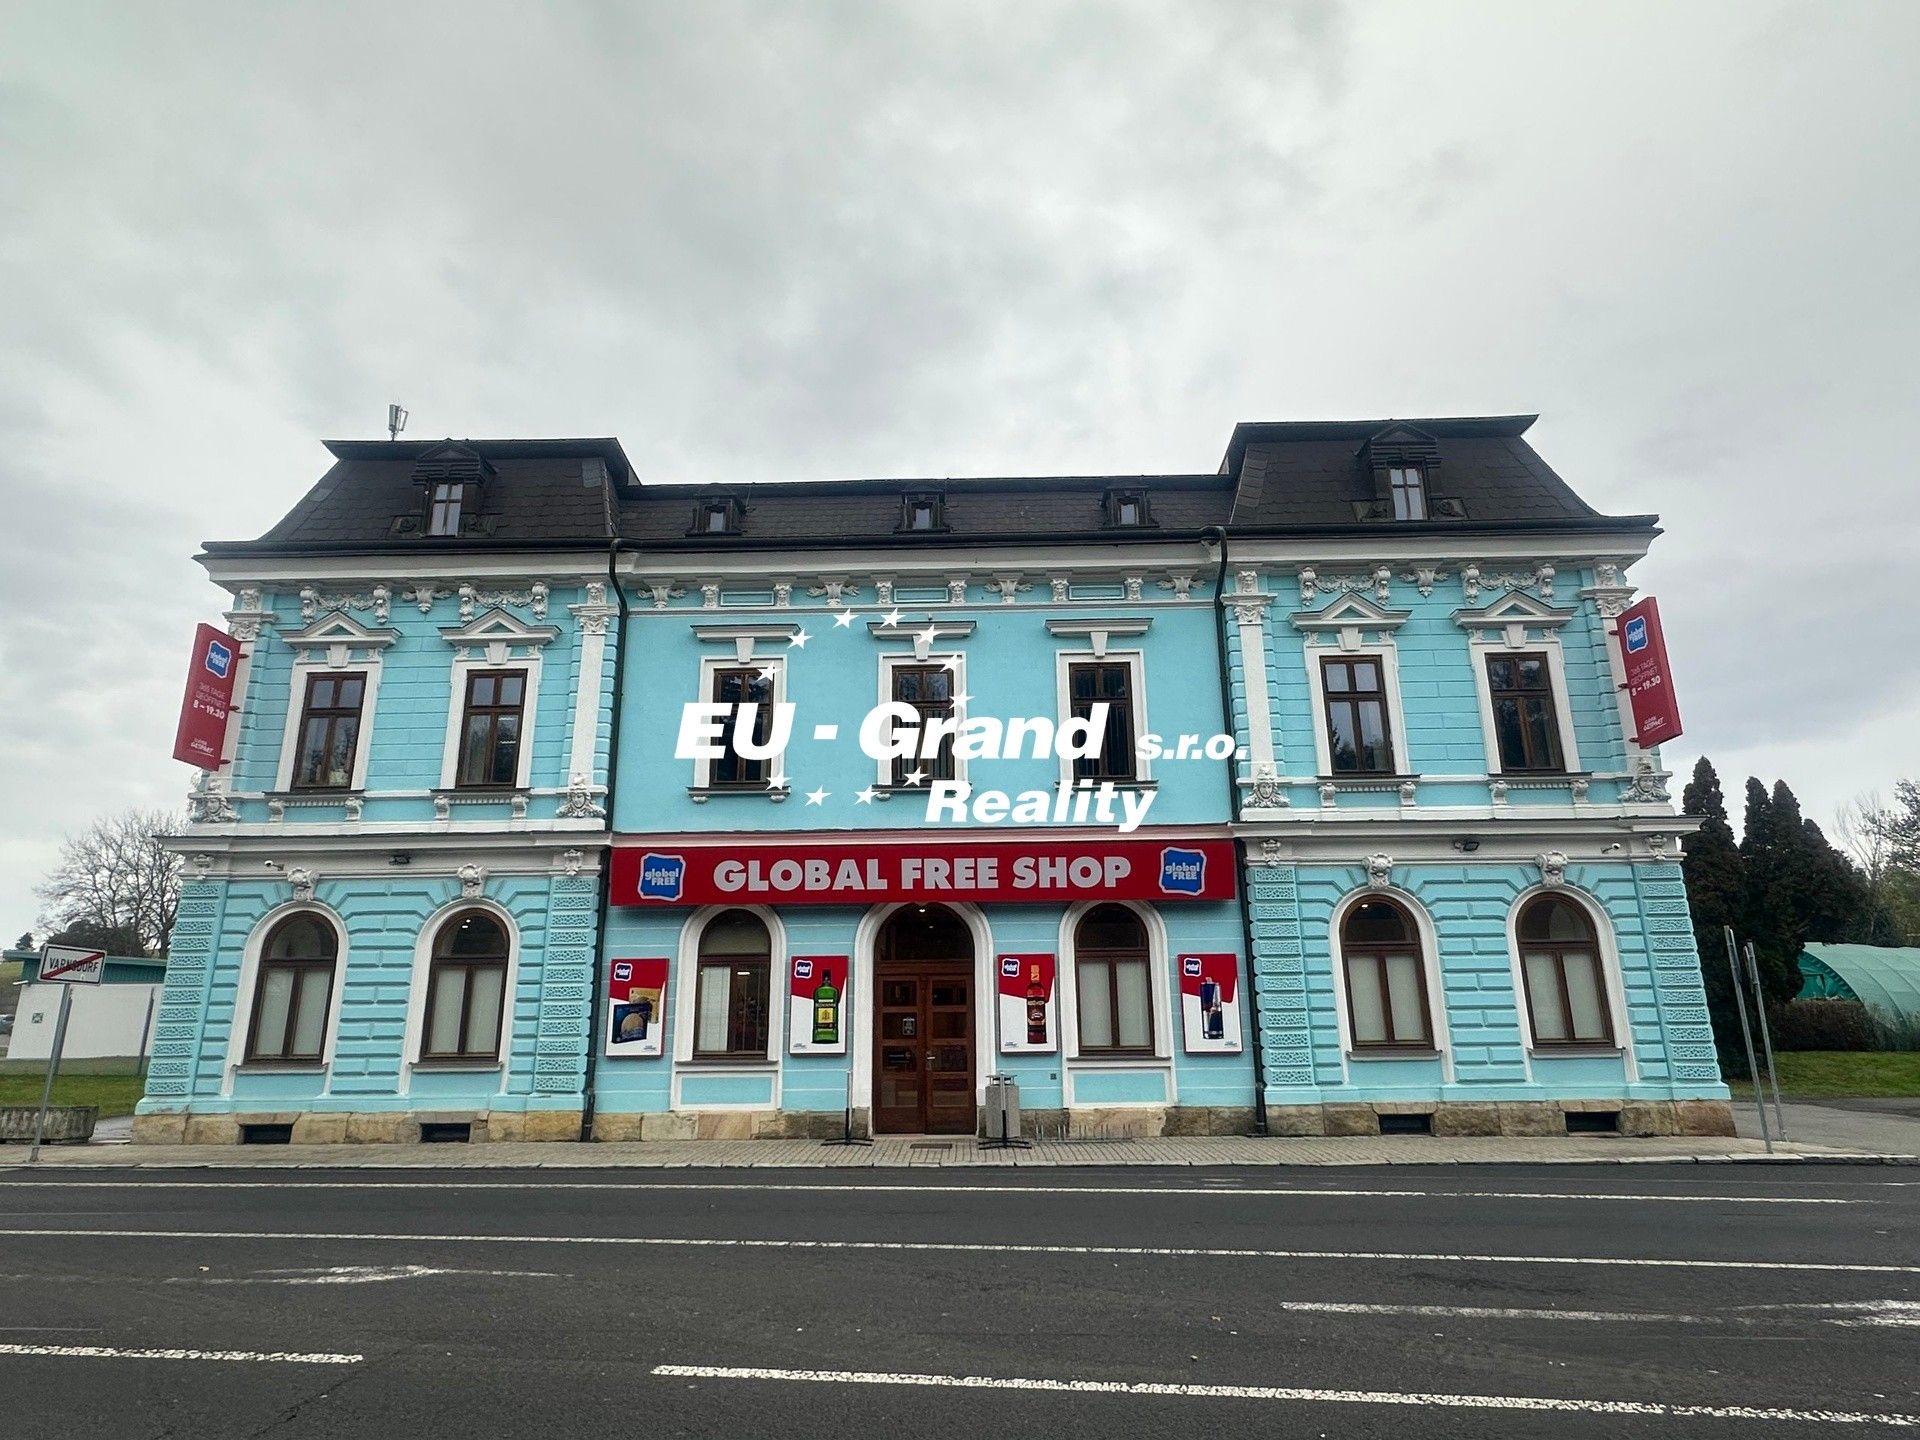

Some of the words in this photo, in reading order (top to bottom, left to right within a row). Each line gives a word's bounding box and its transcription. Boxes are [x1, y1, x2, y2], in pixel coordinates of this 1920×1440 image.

[1642, 675, 1661, 691] 19.30
[206, 705, 225, 720] 19.30
[645, 868, 679, 880] global
[713, 858, 888, 892] GLOBAL
[901, 857, 999, 890] FREE
[1012, 856, 1132, 889] SHOP
[1165, 862, 1200, 875] global
[651, 877, 676, 886] FREE
[1172, 871, 1197, 880] FREE
